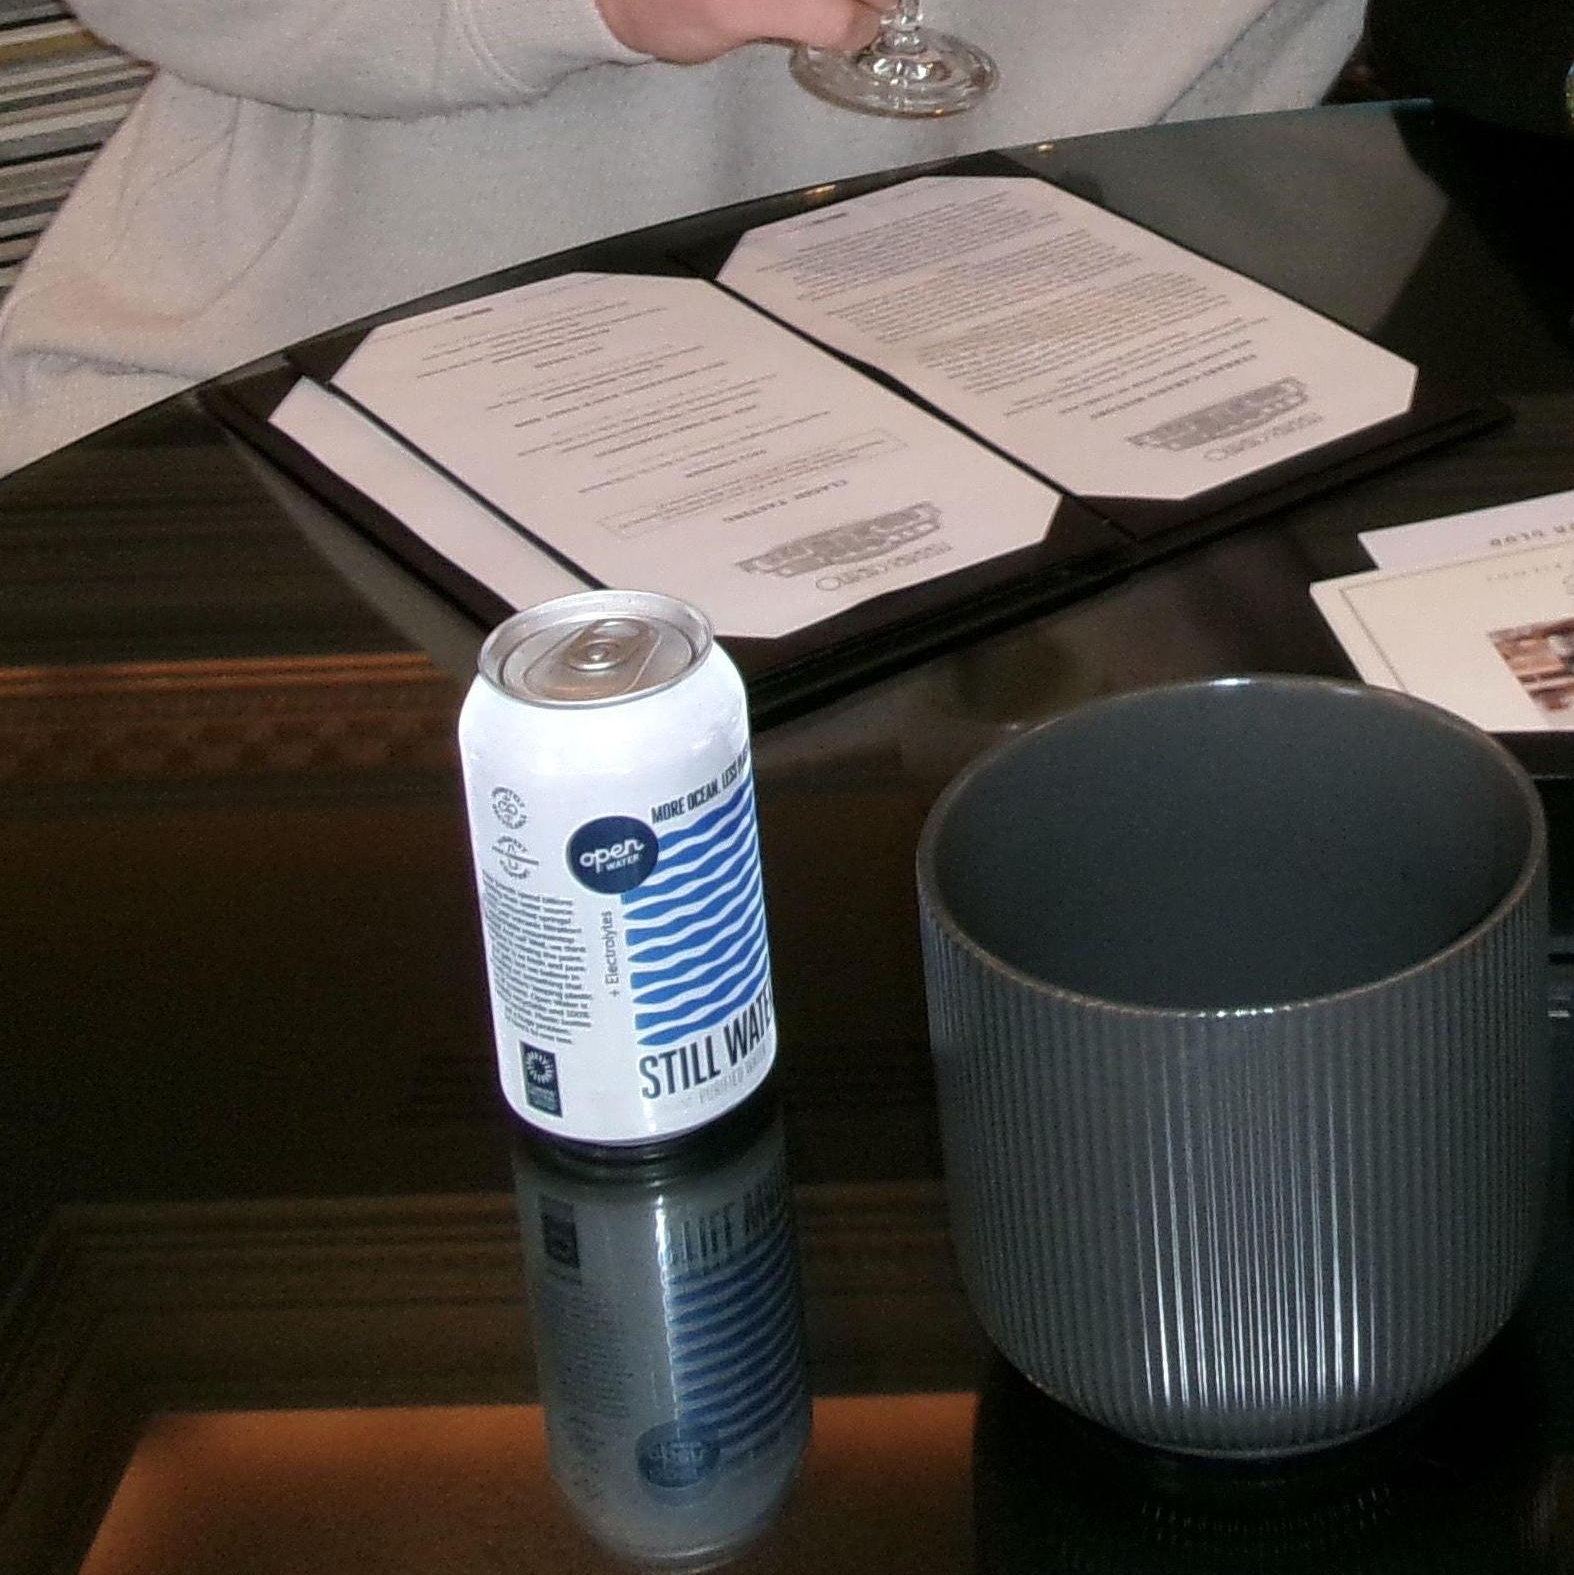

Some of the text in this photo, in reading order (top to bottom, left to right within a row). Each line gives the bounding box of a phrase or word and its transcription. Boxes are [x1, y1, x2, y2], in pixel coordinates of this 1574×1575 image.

[650, 796, 685, 825] MORE
[686, 778, 720, 811] OCEAN.
[721, 759, 737, 790] LESS
[579, 838, 645, 874] open
[605, 853, 640, 872] WATER
[601, 910, 620, 985] Electrolytes
[639, 1033, 722, 1100] STILL
[723, 981, 773, 1068] WATE
